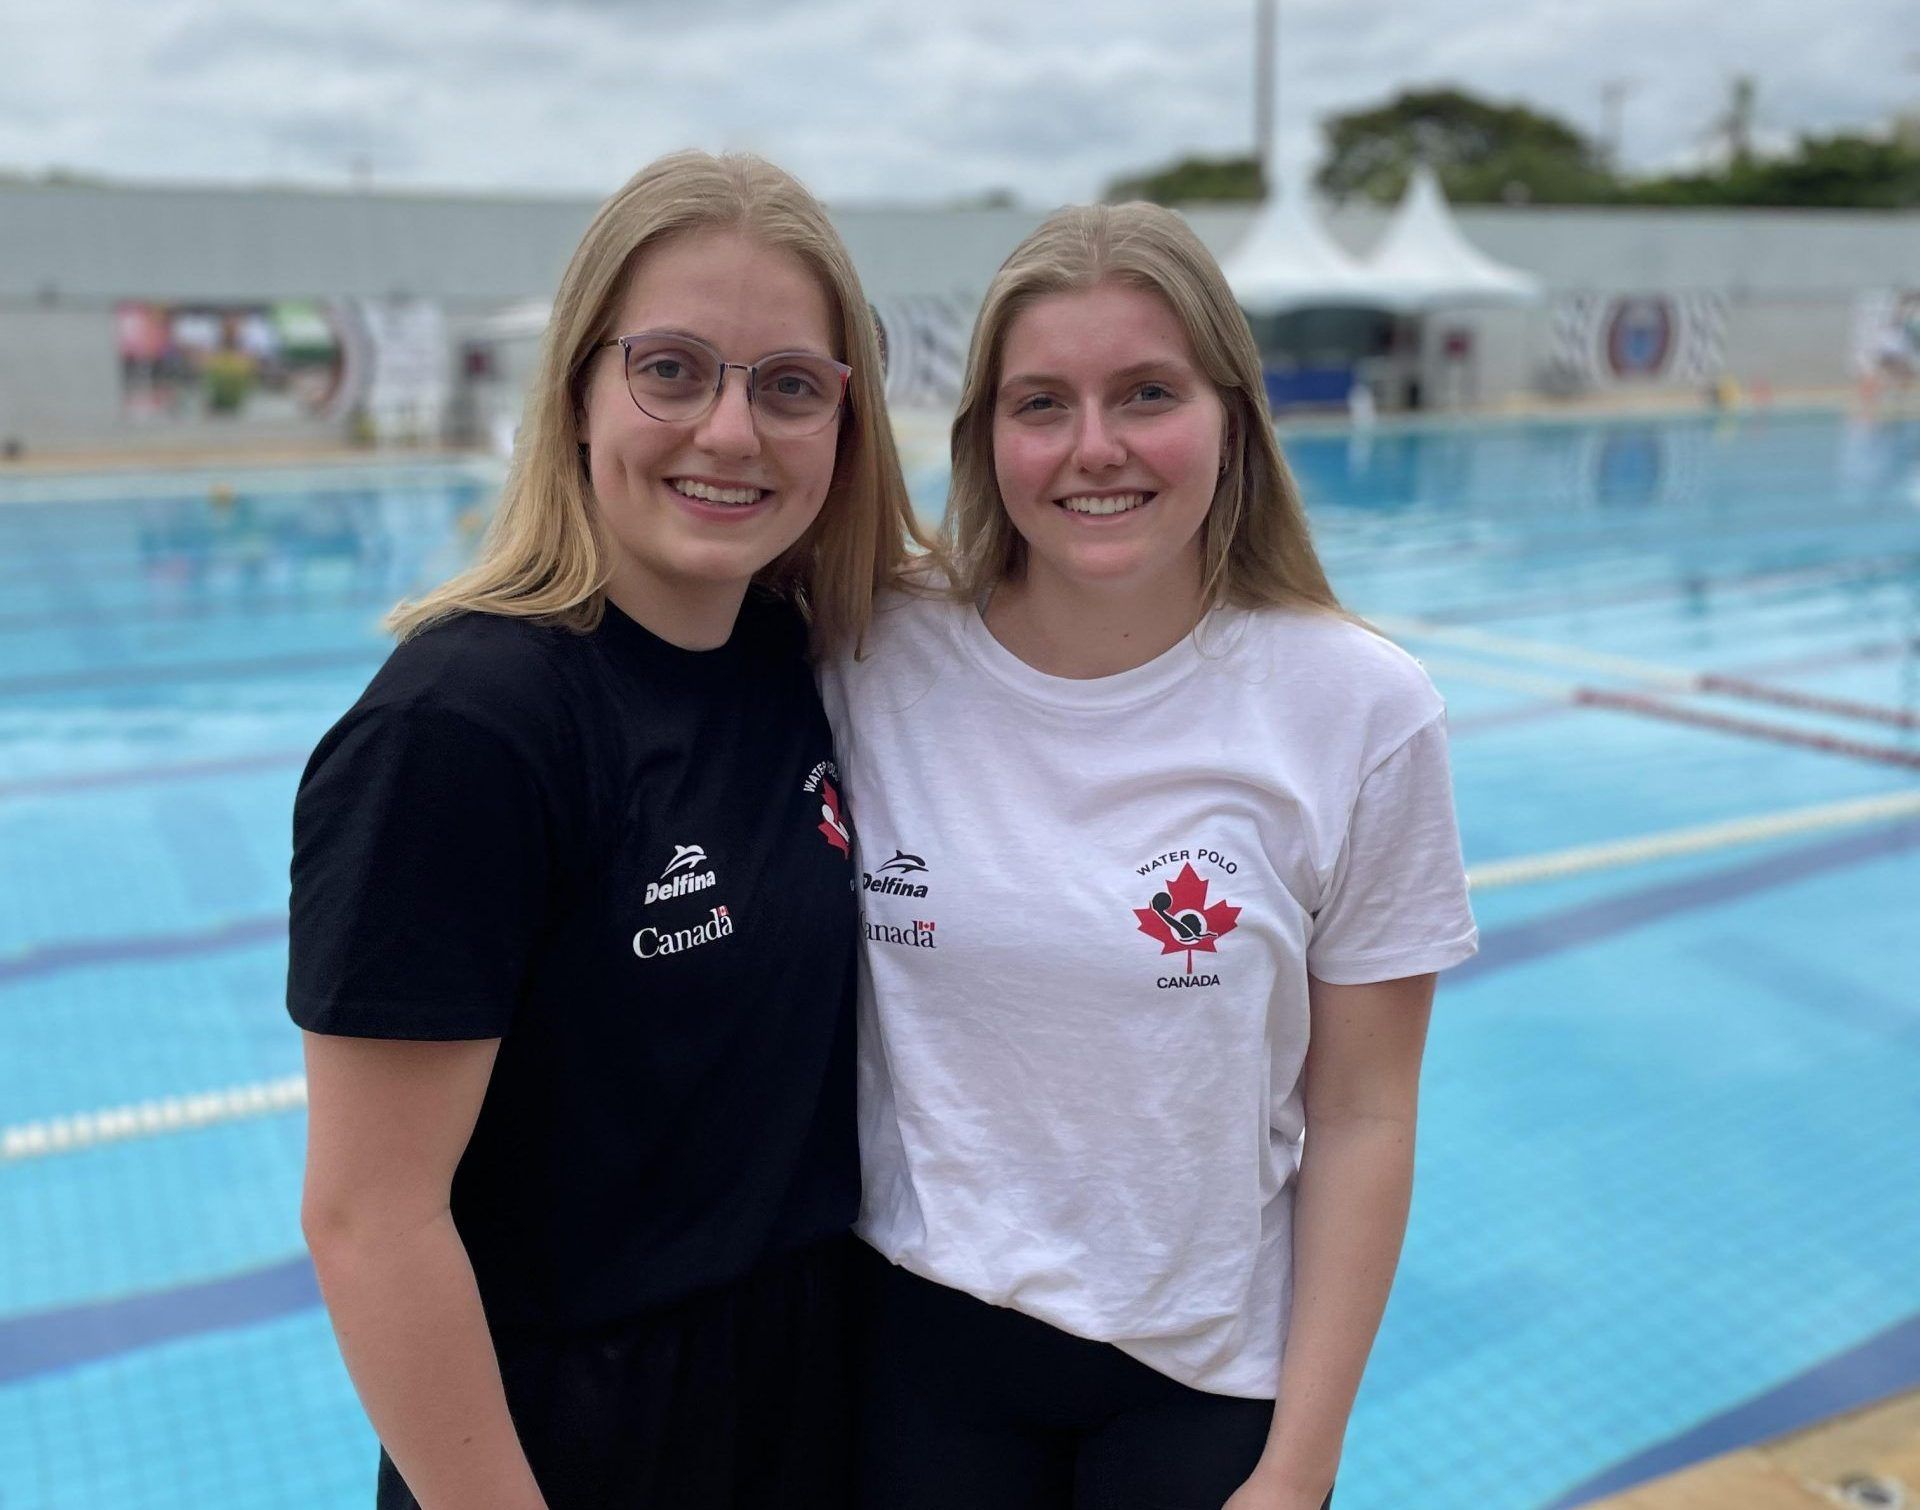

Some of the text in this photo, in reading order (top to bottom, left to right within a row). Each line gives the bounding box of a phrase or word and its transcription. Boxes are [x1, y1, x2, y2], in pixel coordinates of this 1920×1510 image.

[1136, 848, 1238, 876] WATER POLO
[644, 870, 717, 905] Delfina
[632, 907, 734, 959] Canada
[1156, 974, 1221, 989] CANADA
